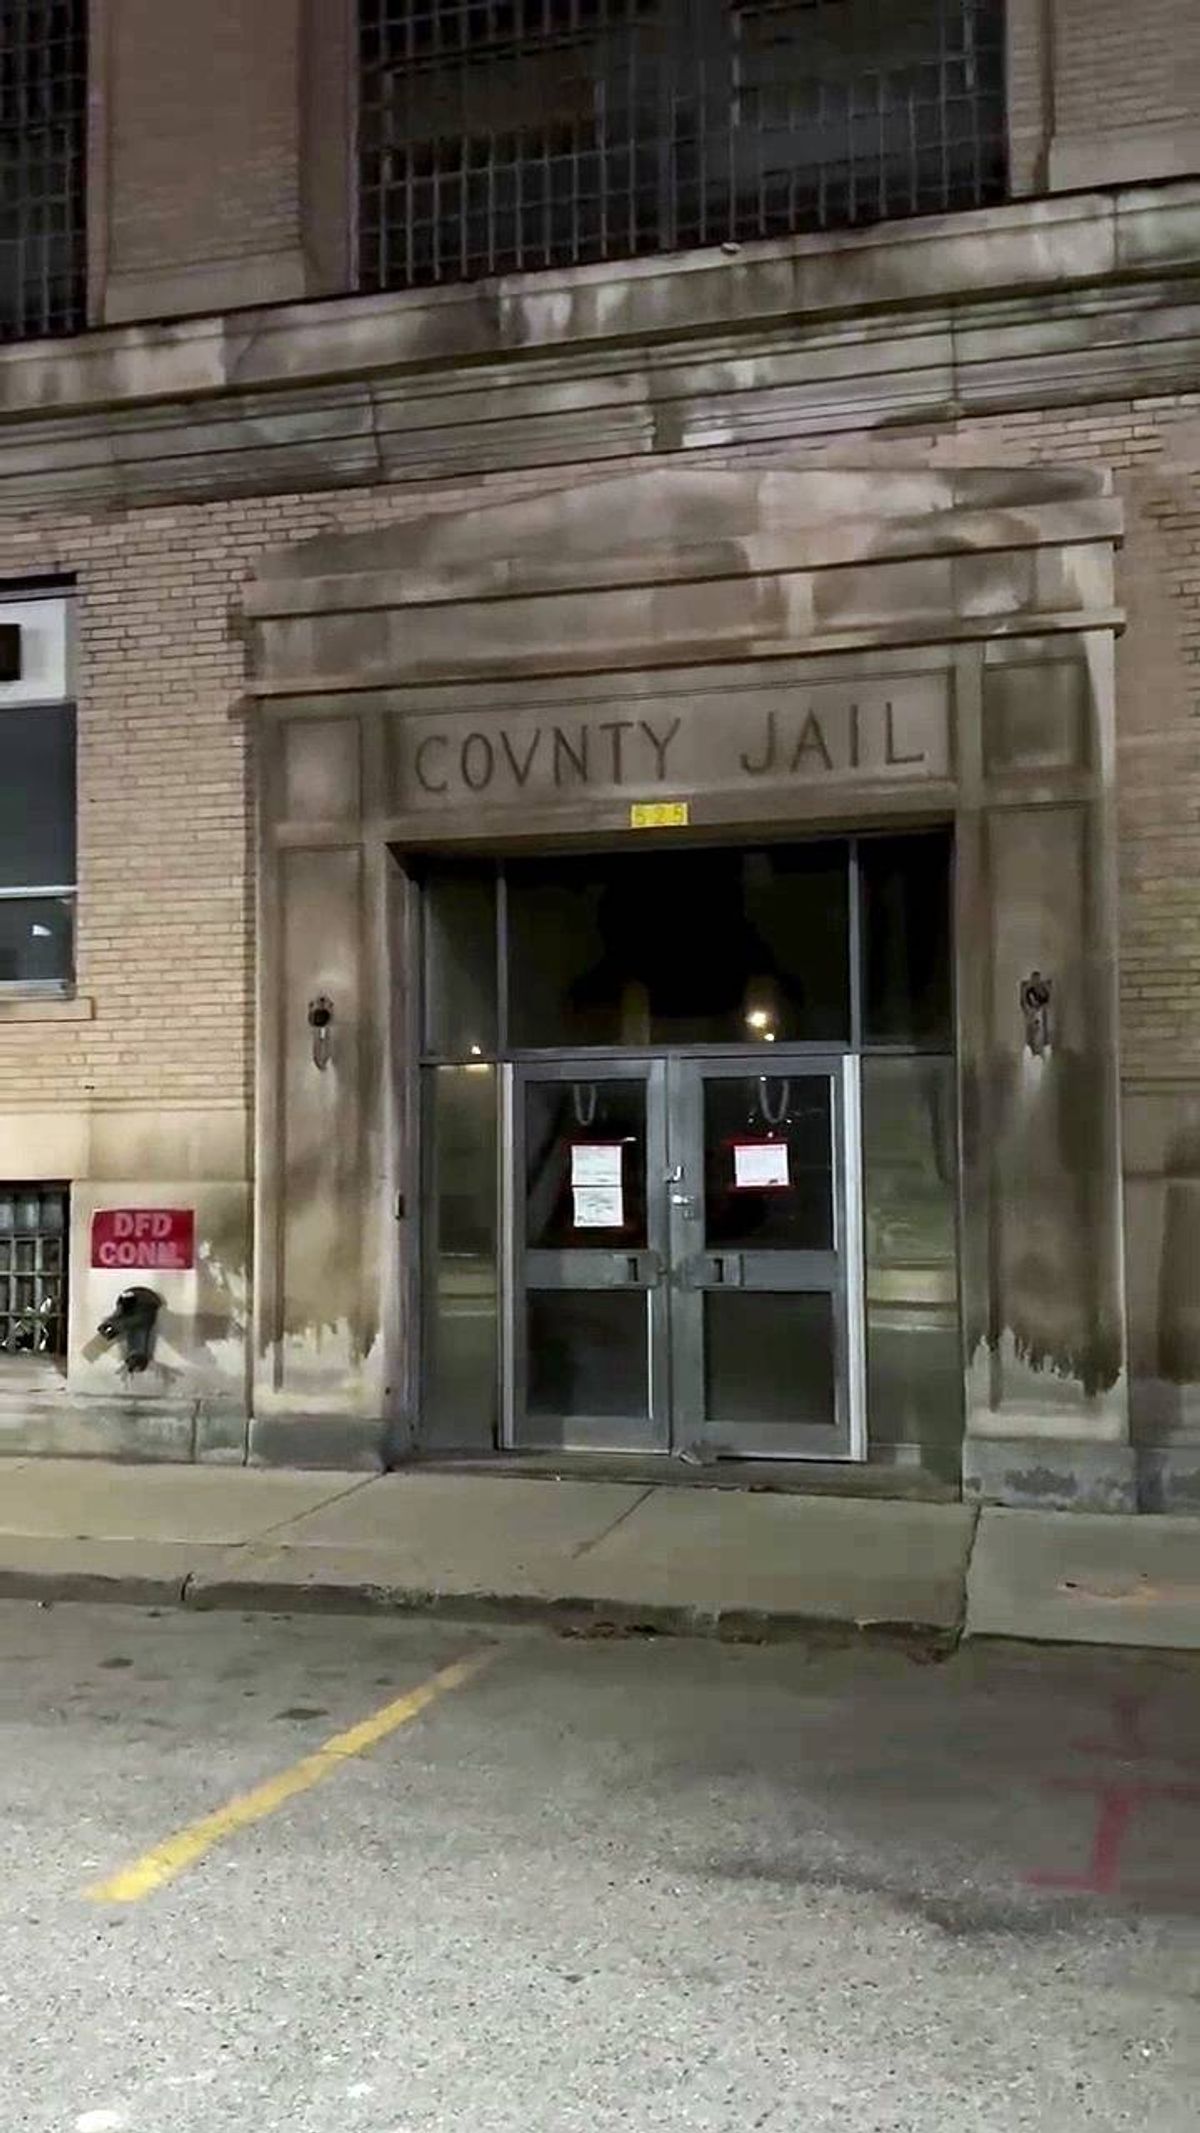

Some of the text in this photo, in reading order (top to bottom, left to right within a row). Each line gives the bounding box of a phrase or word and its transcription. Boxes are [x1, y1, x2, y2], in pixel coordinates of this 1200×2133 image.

[414, 702, 924, 793] COVNTY JAIL
[634, 805, 684, 826] 525
[114, 1213, 172, 1237] DFD
